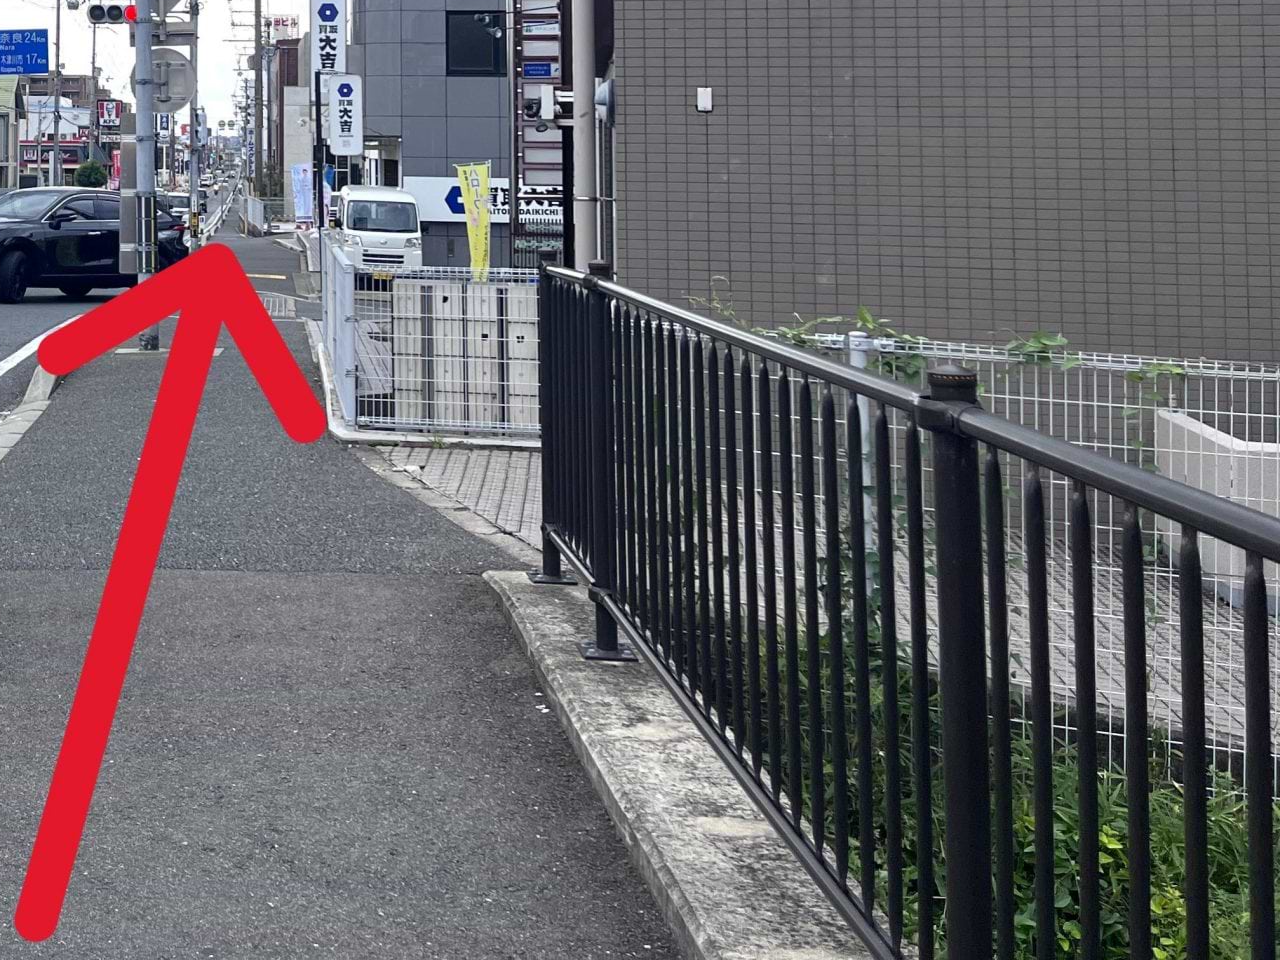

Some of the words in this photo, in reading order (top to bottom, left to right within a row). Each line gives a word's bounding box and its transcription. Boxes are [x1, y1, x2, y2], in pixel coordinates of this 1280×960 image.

[0, 33, 23, 44] 奈良
[1, 54, 23, 65] 木津川市
[519, 208, 559, 216] DAIKICHI
